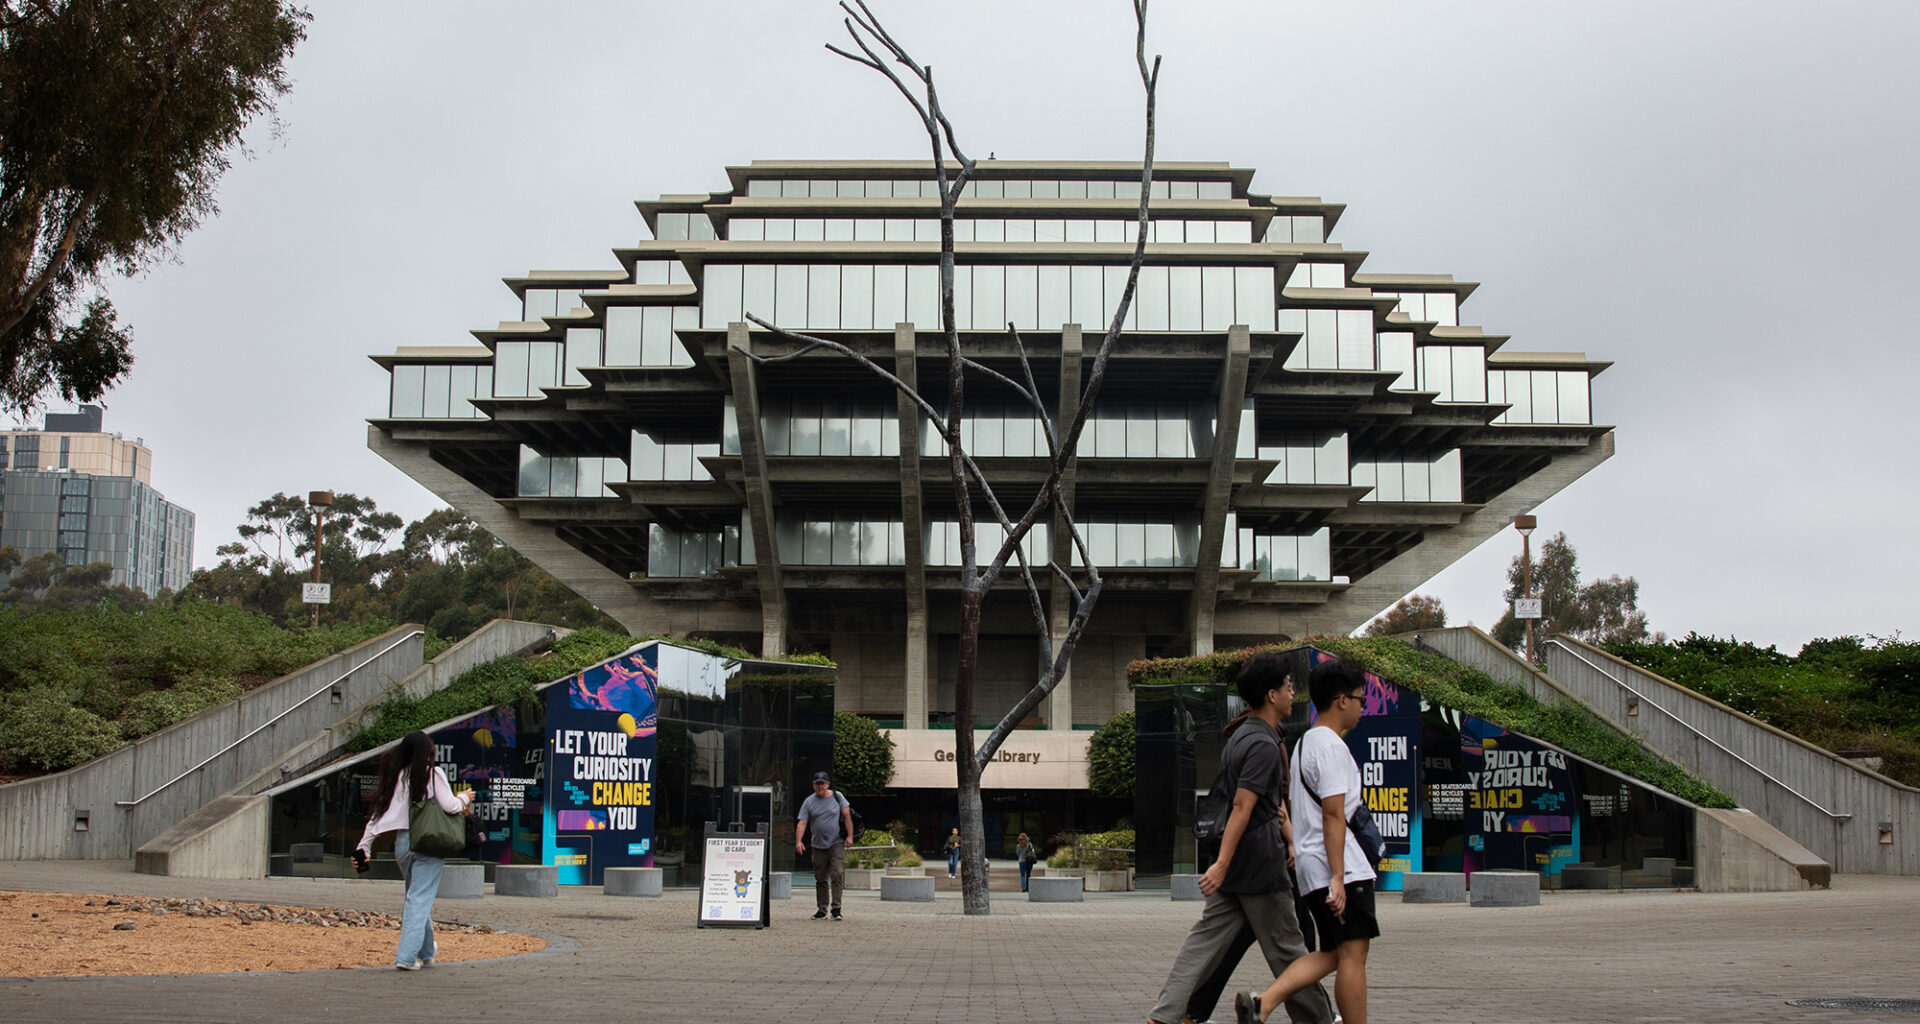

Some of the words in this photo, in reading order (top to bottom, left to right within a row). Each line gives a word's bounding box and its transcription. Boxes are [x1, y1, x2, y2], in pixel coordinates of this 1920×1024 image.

[555, 729, 584, 754] LET
[587, 731, 627, 756] YOUR
[1368, 736, 1407, 760] THEN
[573, 756, 652, 781] CURIOSITY
[1363, 762, 1384, 786] GO
[592, 781, 652, 806] CHANGE
[607, 806, 637, 830] YOU
